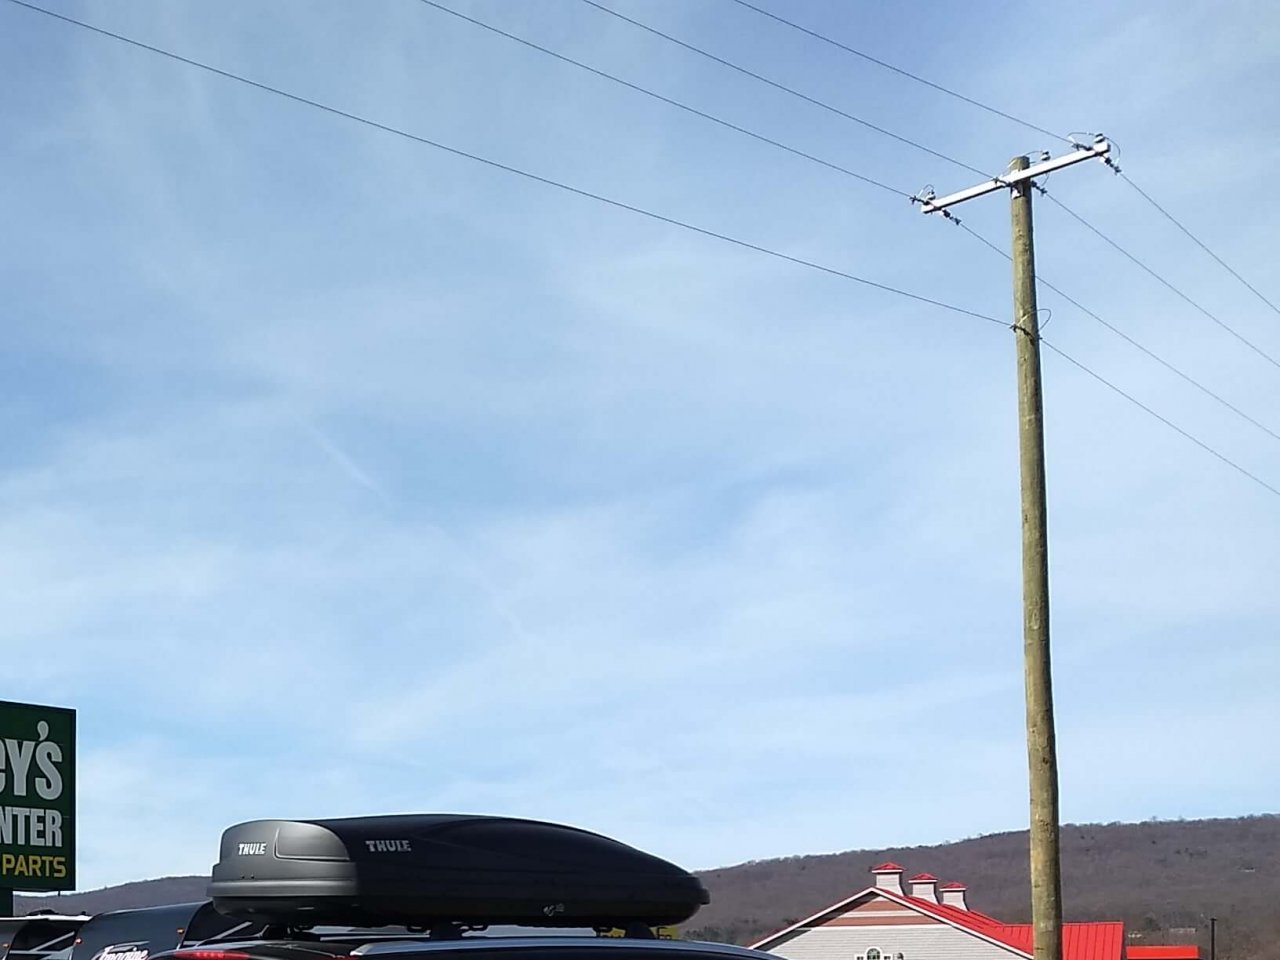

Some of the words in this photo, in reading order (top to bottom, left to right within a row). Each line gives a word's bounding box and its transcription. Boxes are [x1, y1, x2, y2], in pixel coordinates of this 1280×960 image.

[238, 843, 267, 855] THULE
[365, 840, 412, 852] THULE
[2, 853, 67, 878] PARTS
